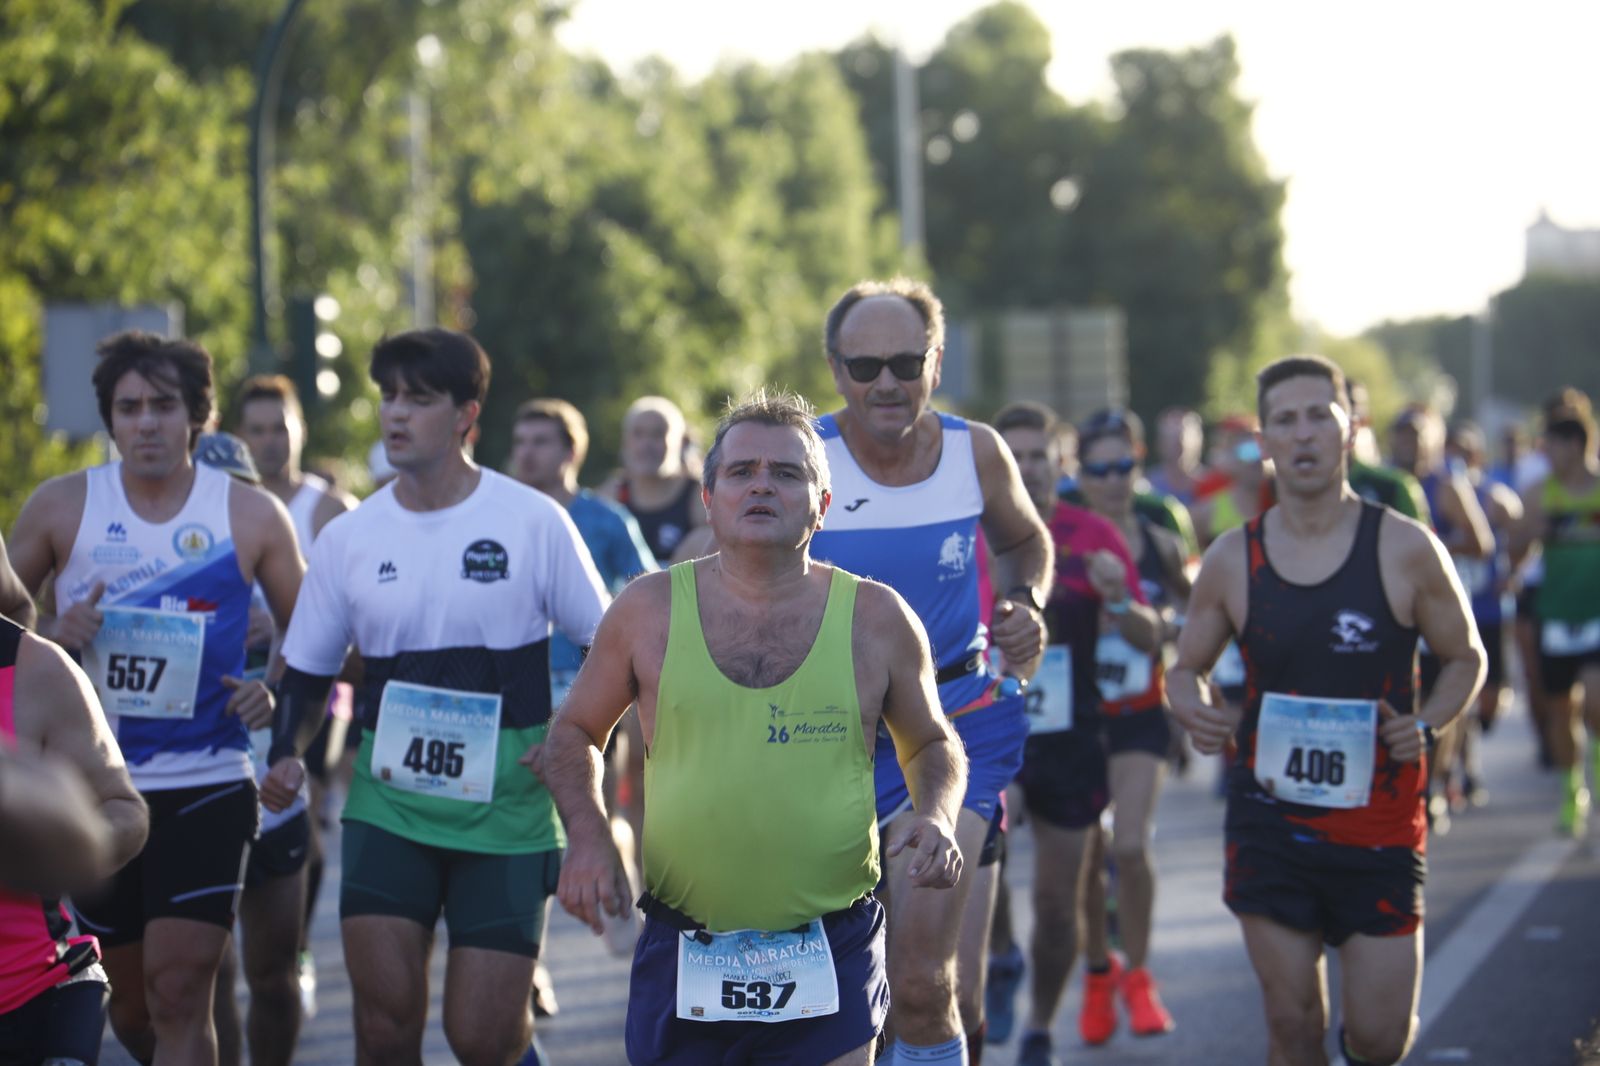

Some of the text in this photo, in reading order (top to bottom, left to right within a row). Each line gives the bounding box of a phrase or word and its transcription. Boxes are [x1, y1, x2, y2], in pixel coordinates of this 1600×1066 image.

[107, 653, 167, 694] 557
[767, 724, 790, 744] 26
[793, 722, 848, 734] Maratón
[402, 736, 466, 779] 485
[1285, 747, 1345, 787] 406
[687, 952, 741, 968] MEDIA
[745, 939, 824, 967] MARATÓN
[721, 980, 797, 1010] 537
